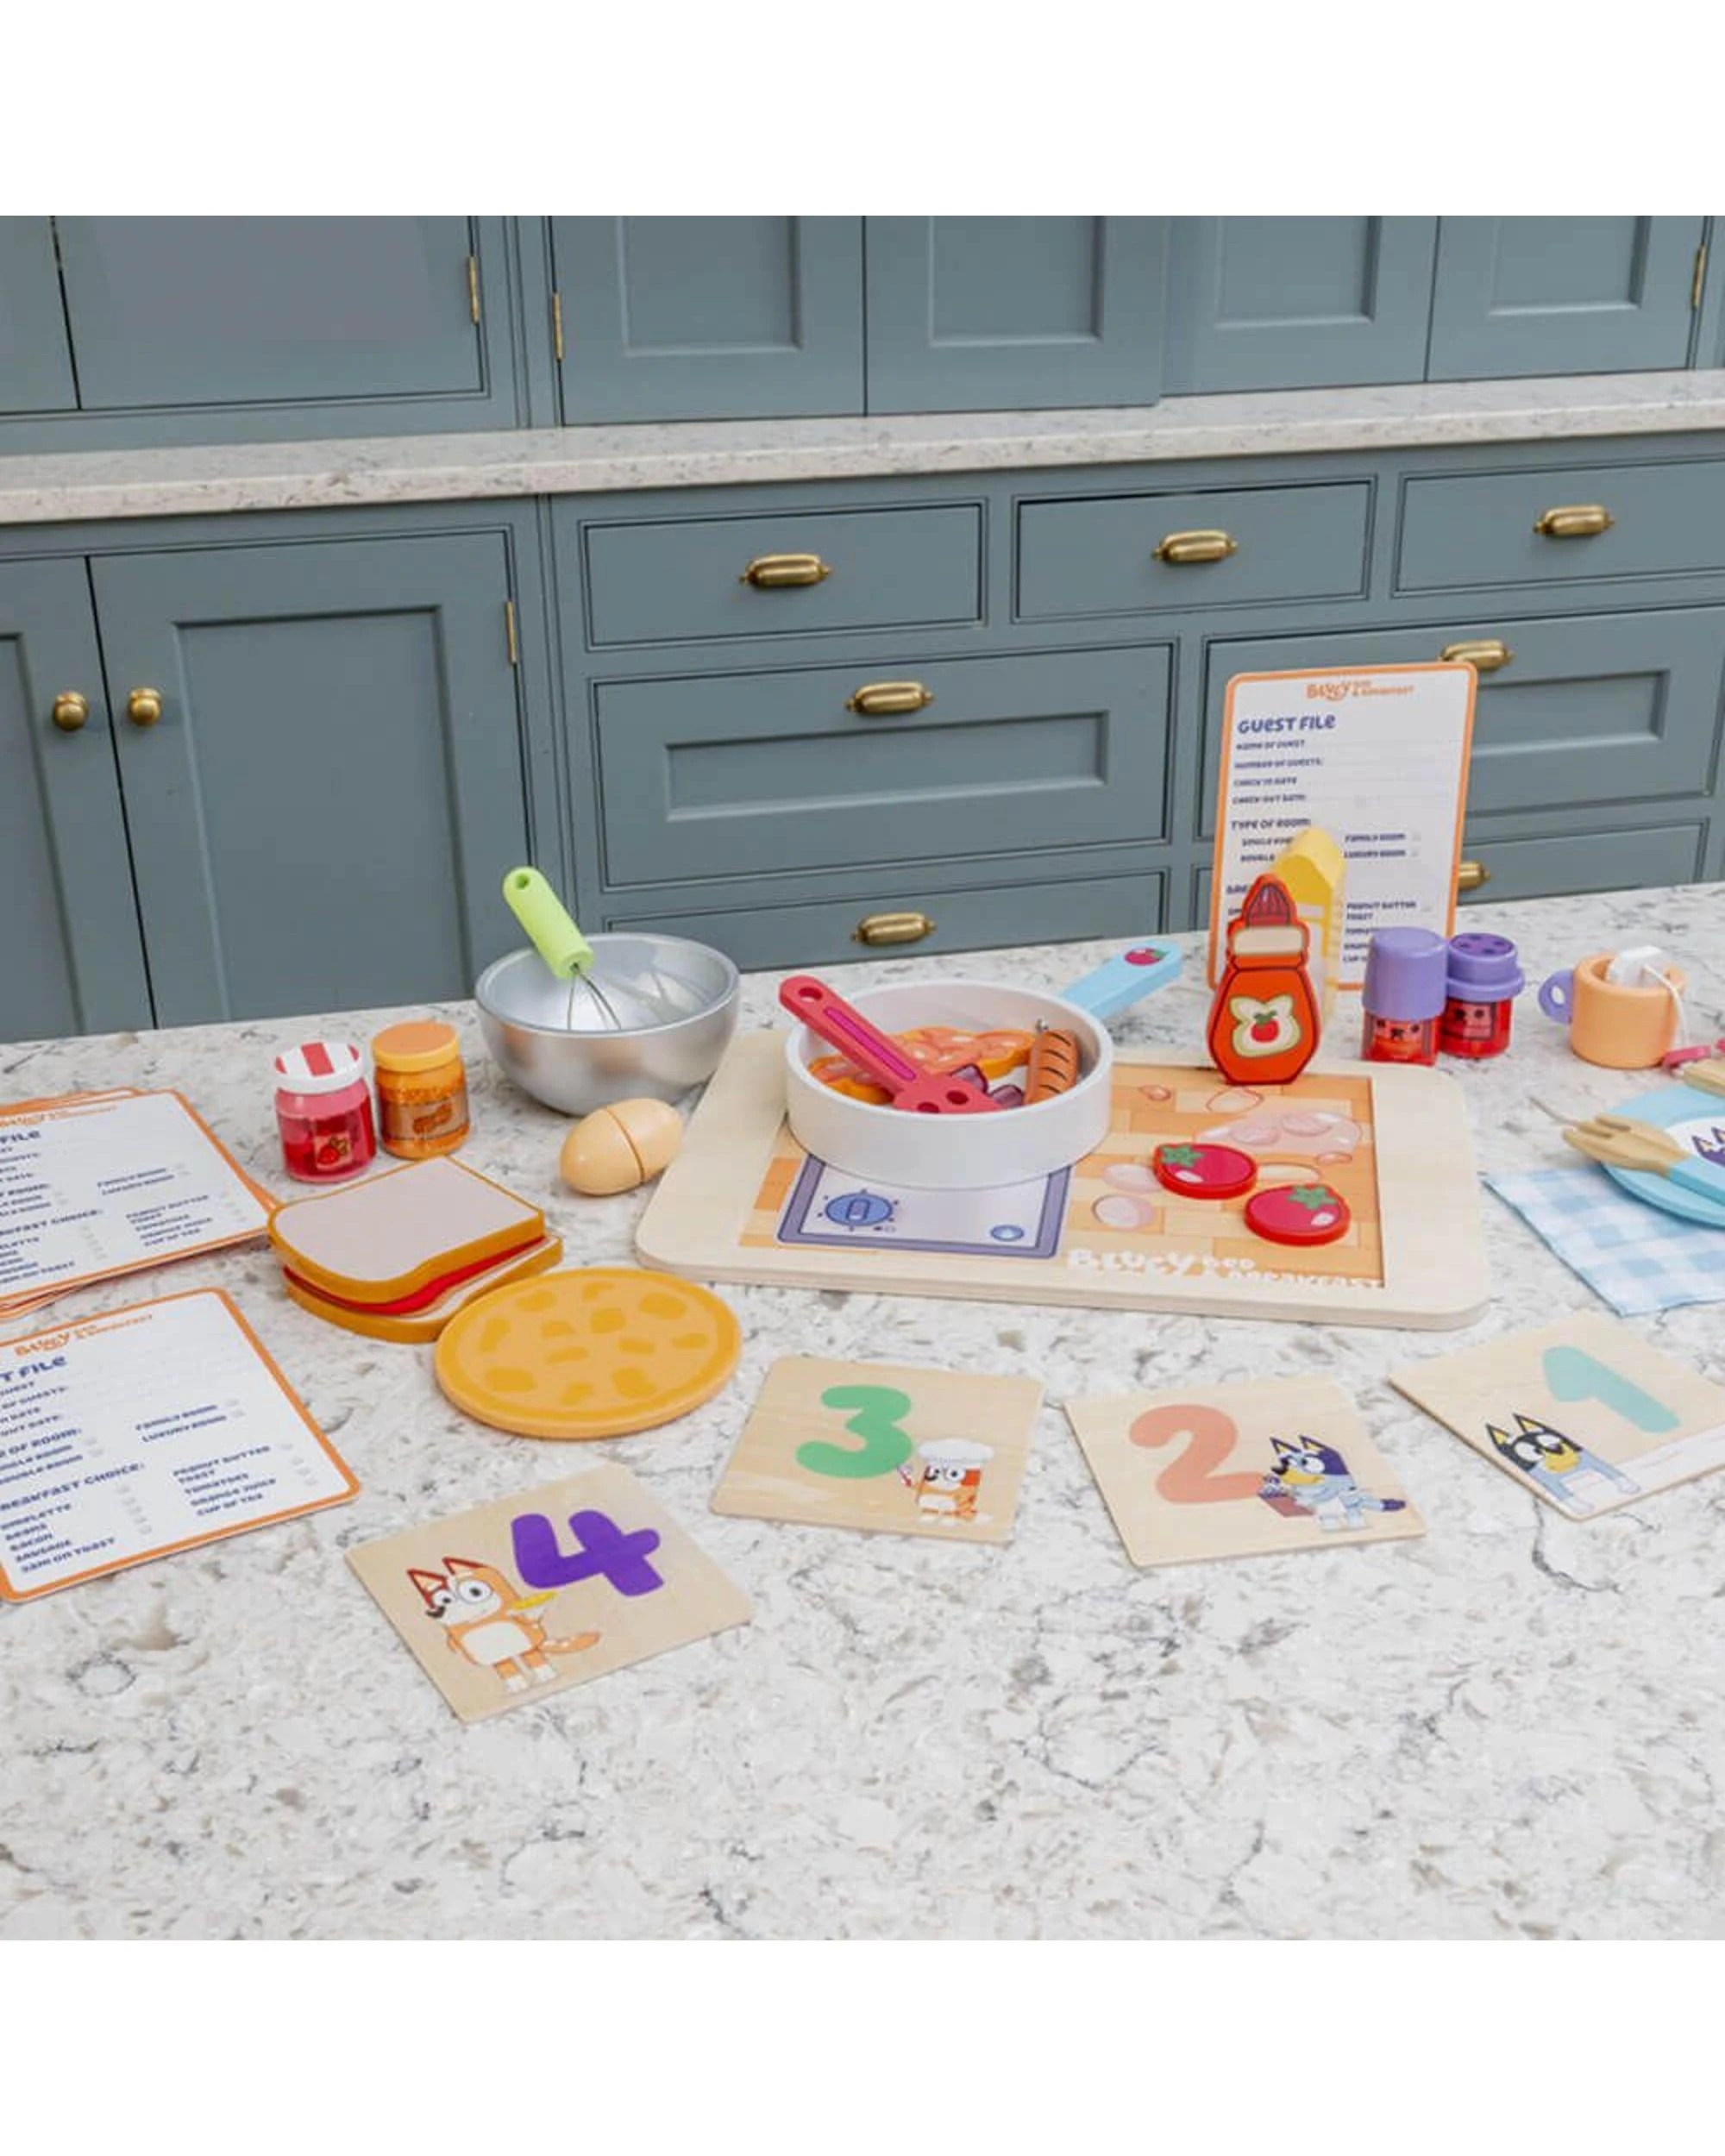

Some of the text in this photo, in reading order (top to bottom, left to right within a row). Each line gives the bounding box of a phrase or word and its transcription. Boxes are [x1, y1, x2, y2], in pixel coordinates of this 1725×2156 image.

[1238, 714, 1336, 734] GUEST FILE
[1232, 820, 1258, 830] TYPE
[1259, 819, 1274, 829] OF
[18, 1356, 66, 1378] FILE
[1541, 1345, 1682, 1434] 1
[795, 1384, 913, 1479] 3
[1128, 1403, 1266, 1505] 2
[0, 1481, 79, 1510] REAKFAST
[511, 1509, 665, 1597] 4
